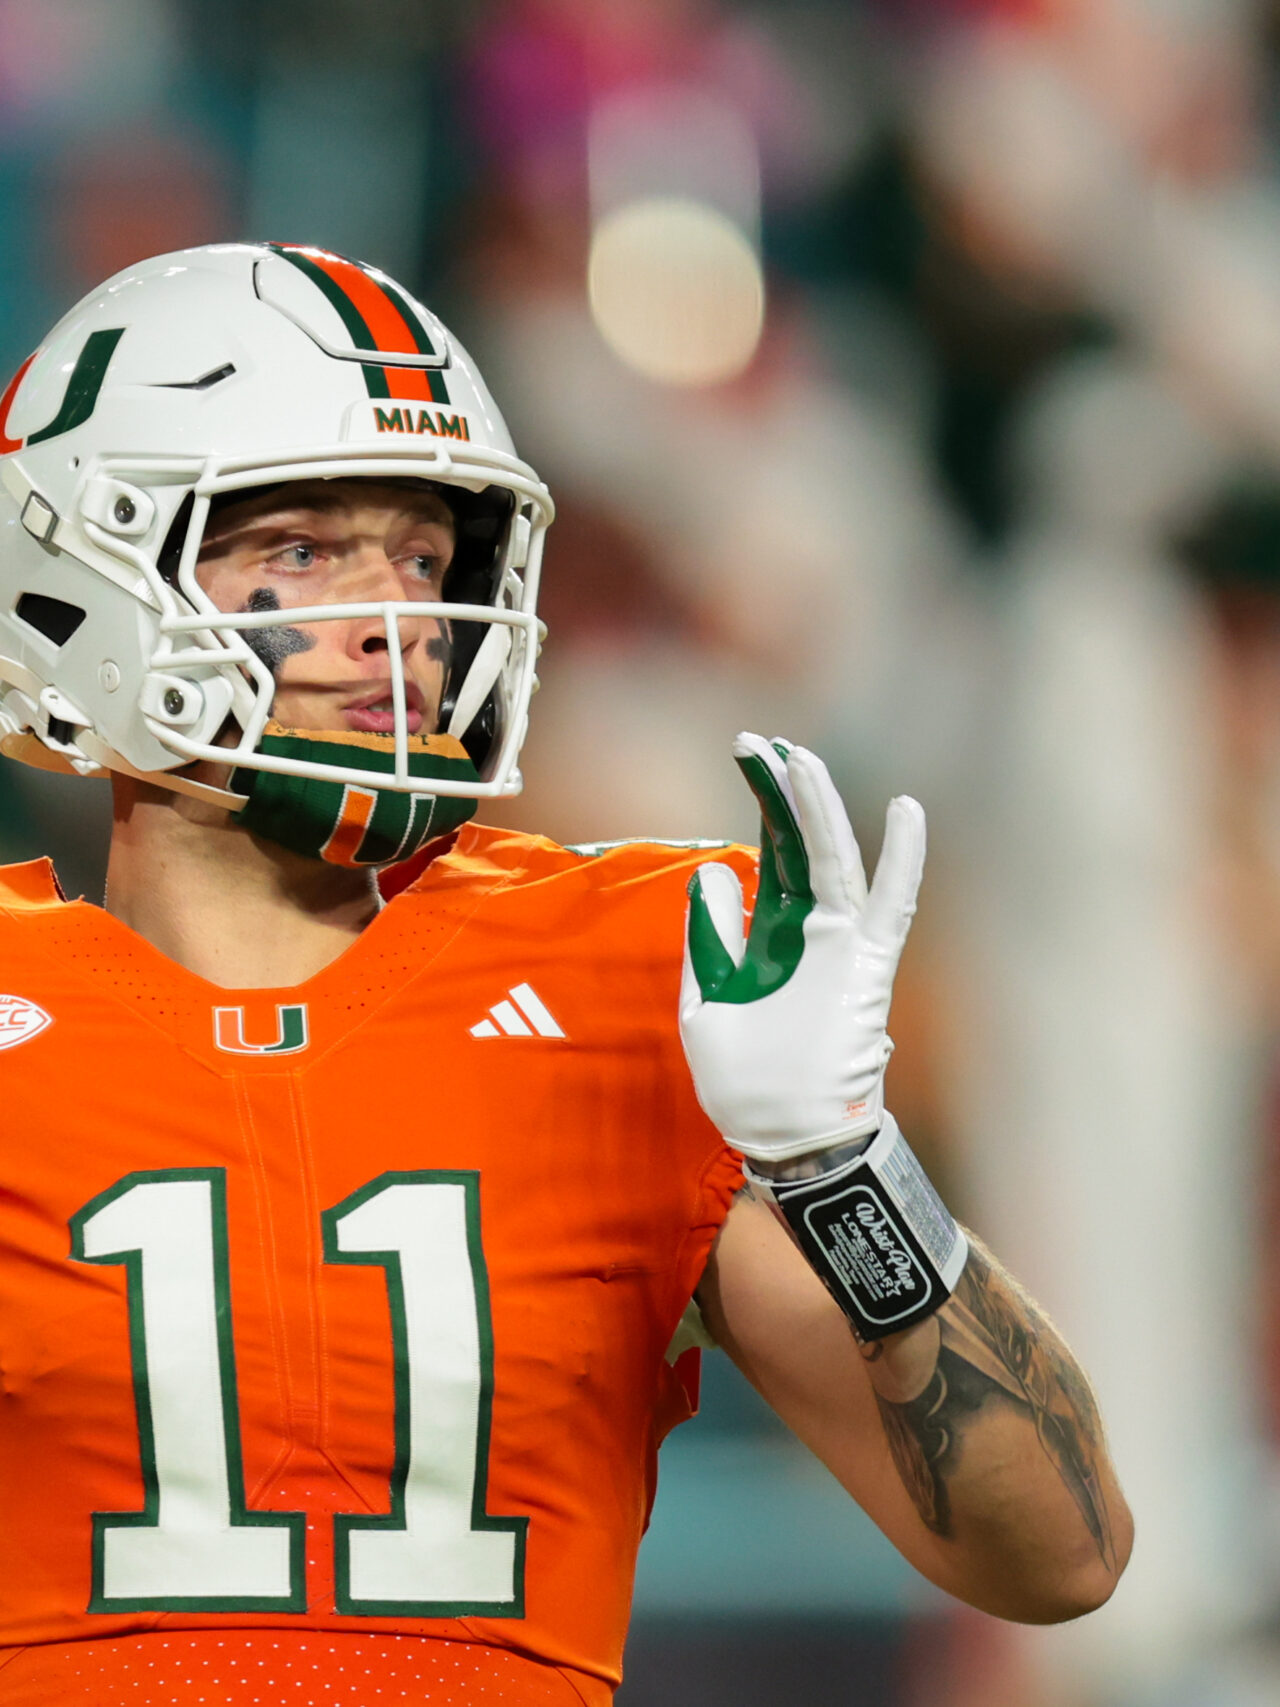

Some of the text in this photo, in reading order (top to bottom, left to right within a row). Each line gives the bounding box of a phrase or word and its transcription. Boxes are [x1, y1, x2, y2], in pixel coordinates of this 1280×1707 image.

[373, 407, 470, 442] MIAMI
[212, 1003, 310, 1056] U
[856, 1202, 895, 1251] Wrist
[67, 1166, 530, 1619] 11
